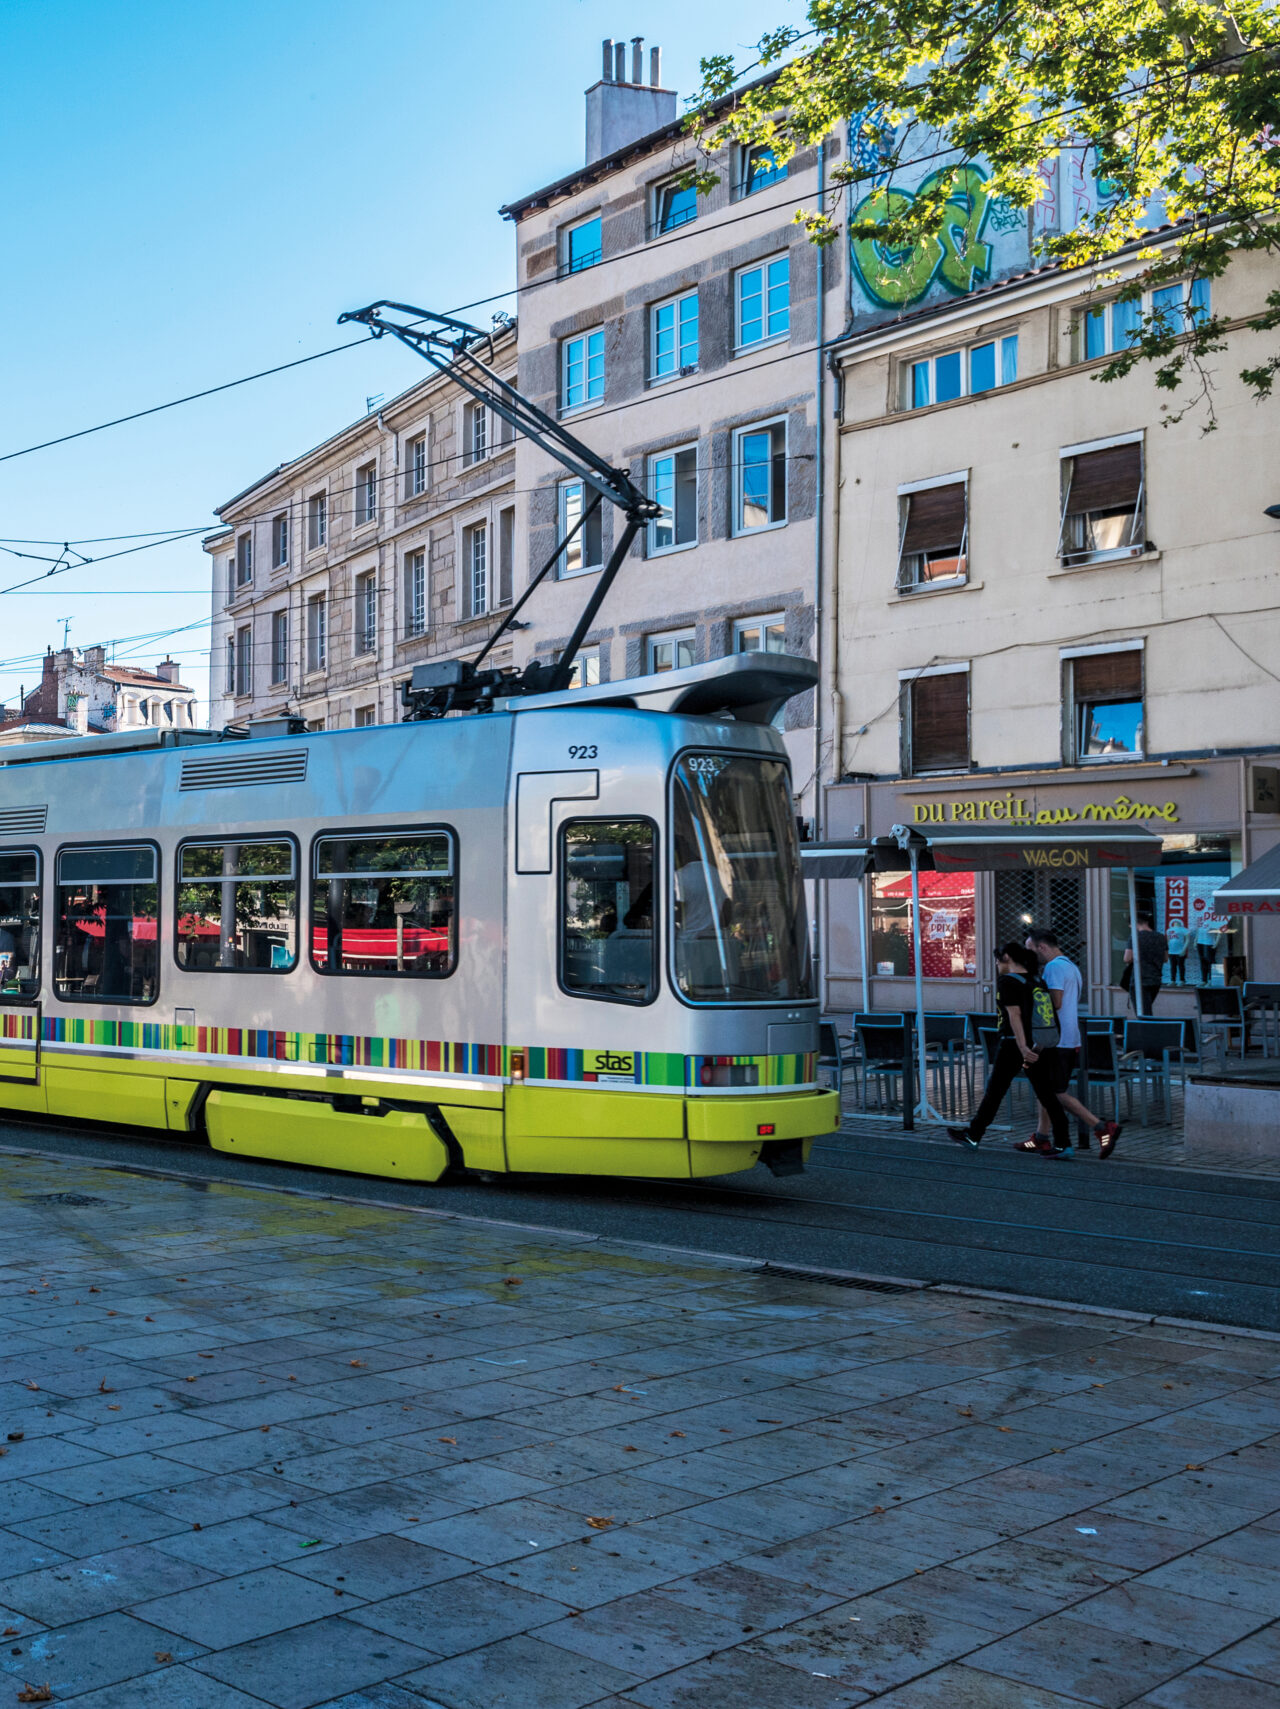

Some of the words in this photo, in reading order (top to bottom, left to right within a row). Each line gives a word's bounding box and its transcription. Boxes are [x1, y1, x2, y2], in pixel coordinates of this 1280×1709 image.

[568, 745, 598, 759] 923
[688, 757, 714, 771] 923
[1081, 795, 1179, 822] même
[1022, 848, 1089, 867] WAGON
[1169, 880, 1185, 929] OLDES
[595, 1050, 632, 1071] stas
